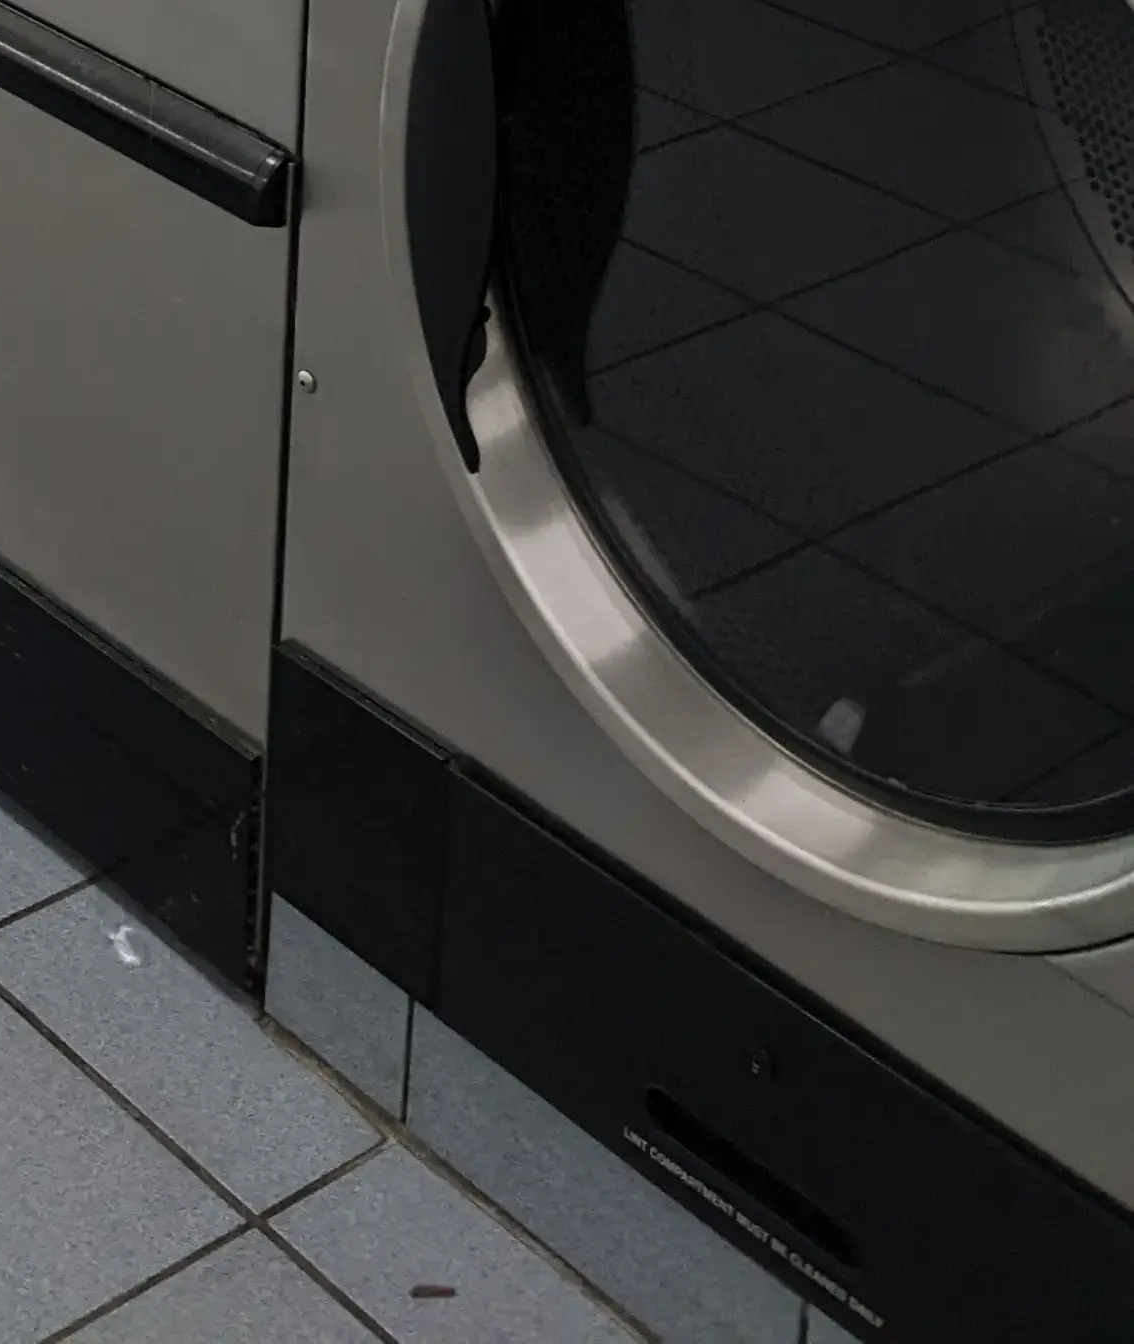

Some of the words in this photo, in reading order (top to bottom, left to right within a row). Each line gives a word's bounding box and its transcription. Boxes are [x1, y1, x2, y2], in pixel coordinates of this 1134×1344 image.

[623, 1125, 648, 1152] LINT
[649, 1146, 735, 1217] COMPARTMENT
[736, 1211, 770, 1243] MUST
